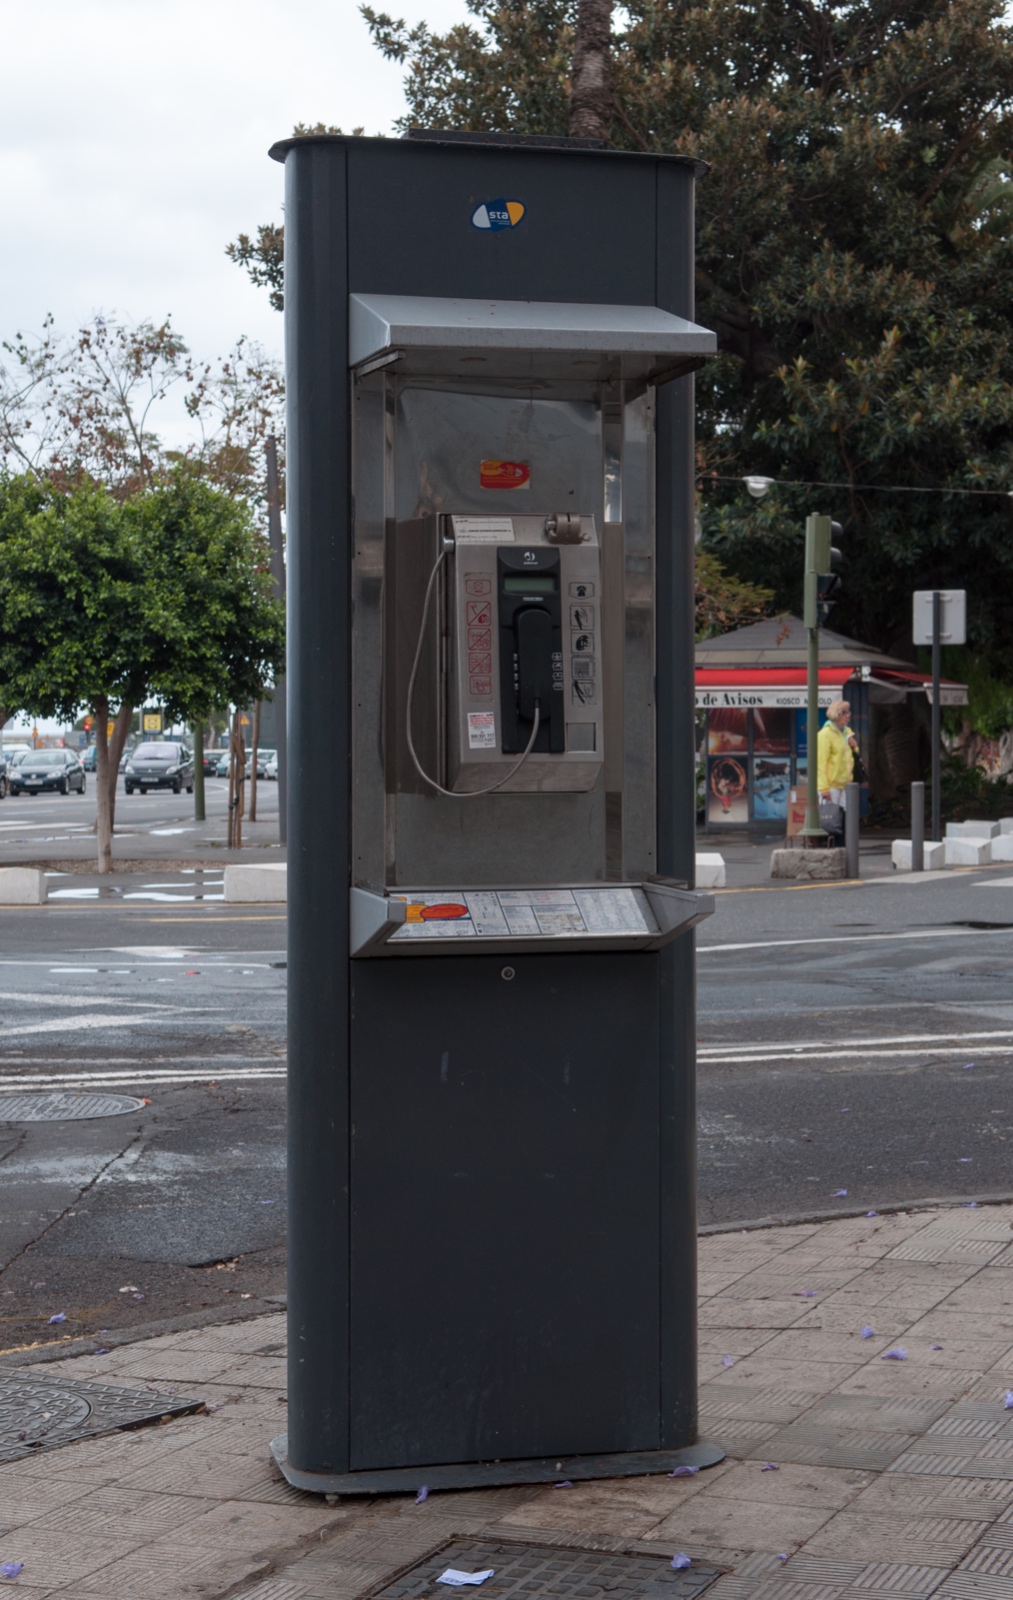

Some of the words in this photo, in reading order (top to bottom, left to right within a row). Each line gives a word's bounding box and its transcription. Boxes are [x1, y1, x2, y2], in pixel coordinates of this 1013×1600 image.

[489, 211, 508, 219] sta
[703, 692, 718, 705] de
[721, 692, 764, 705] Avisos
[776, 697, 800, 705] KIOSCO
